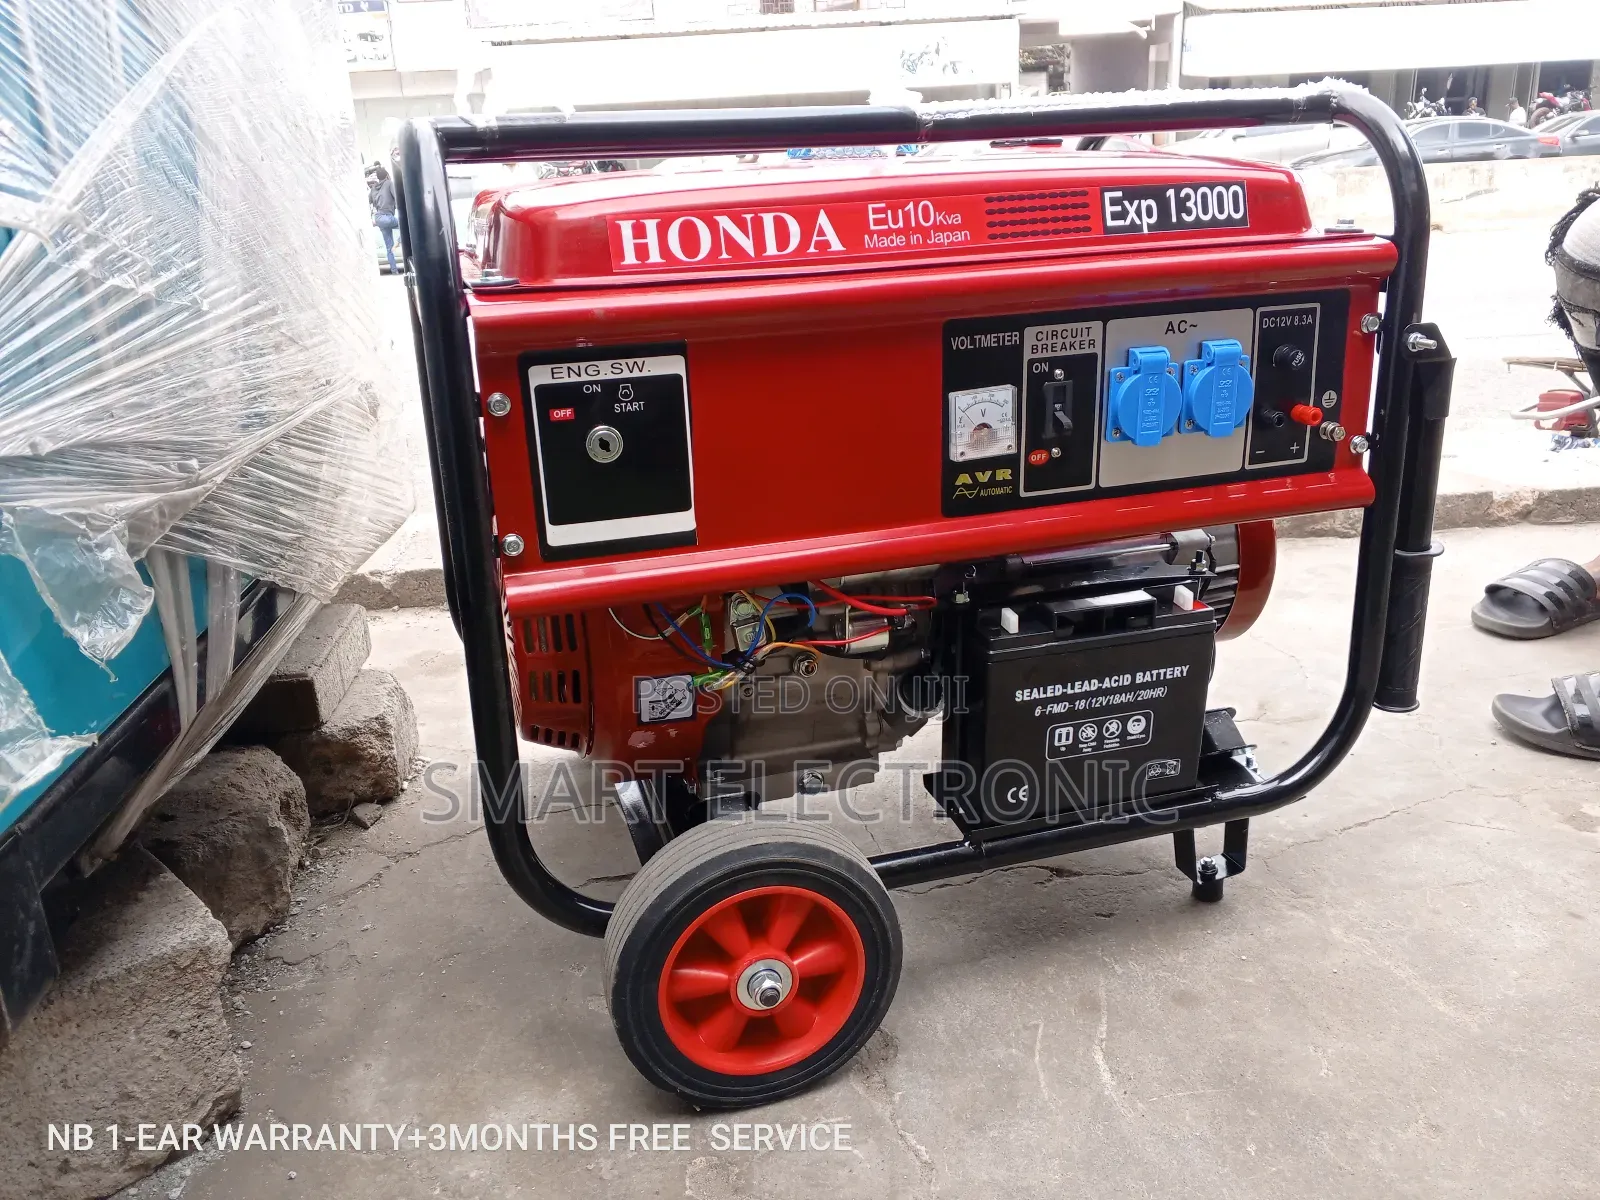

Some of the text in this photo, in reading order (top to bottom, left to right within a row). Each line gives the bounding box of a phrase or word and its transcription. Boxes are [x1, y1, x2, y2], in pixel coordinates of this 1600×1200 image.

[1104, 184, 1245, 233] Exp 13000
[615, 208, 847, 265] HONDA
[864, 229, 971, 248] Made in Japan
[1262, 314, 1313, 329] DC12V 8.3A
[951, 331, 1020, 350] VOLTMETER
[1036, 326, 1093, 342] CIRCUIT
[1031, 338, 1096, 355] BREAKER
[550, 360, 652, 380] ENG.SW.
[1032, 362, 1049, 374] ON
[583, 384, 602, 394] ON
[553, 408, 573, 419] OFF
[614, 401, 646, 413] START
[980, 408, 987, 418] V
[1030, 453, 1047, 462] OFF
[955, 468, 1013, 486] AVR
[980, 485, 1013, 497] AUTOMATIC
[1014, 665, 1190, 702] SEALED-LEAD-ACID BATTERY
